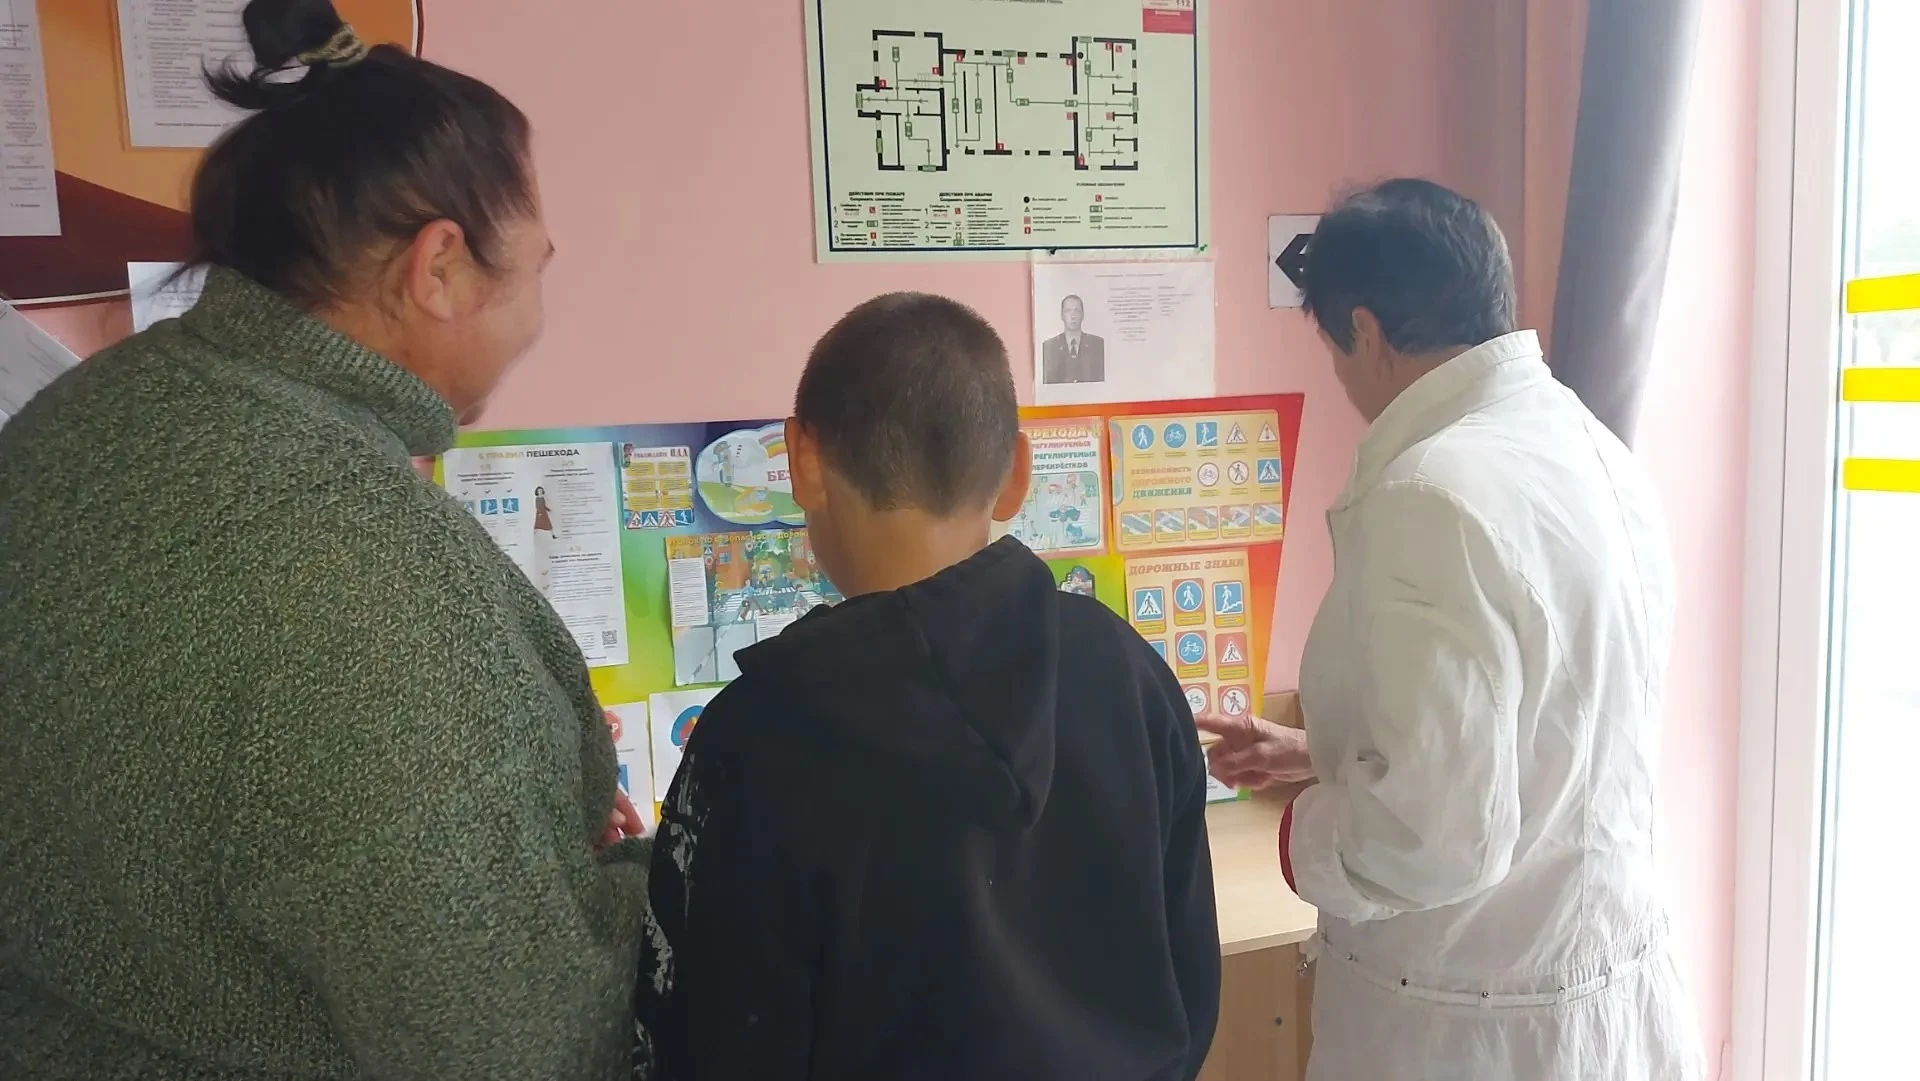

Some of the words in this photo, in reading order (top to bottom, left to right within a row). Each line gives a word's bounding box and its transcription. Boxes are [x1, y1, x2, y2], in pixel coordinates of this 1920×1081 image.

[526, 449, 580, 458] ПЕШЕХОДА
[1132, 487, 1192, 499] ДВИЖЕНИЯ
[1129, 561, 1201, 576] ДОРОЖНЫЕ
[1203, 558, 1245, 570] ЗНАКИ
